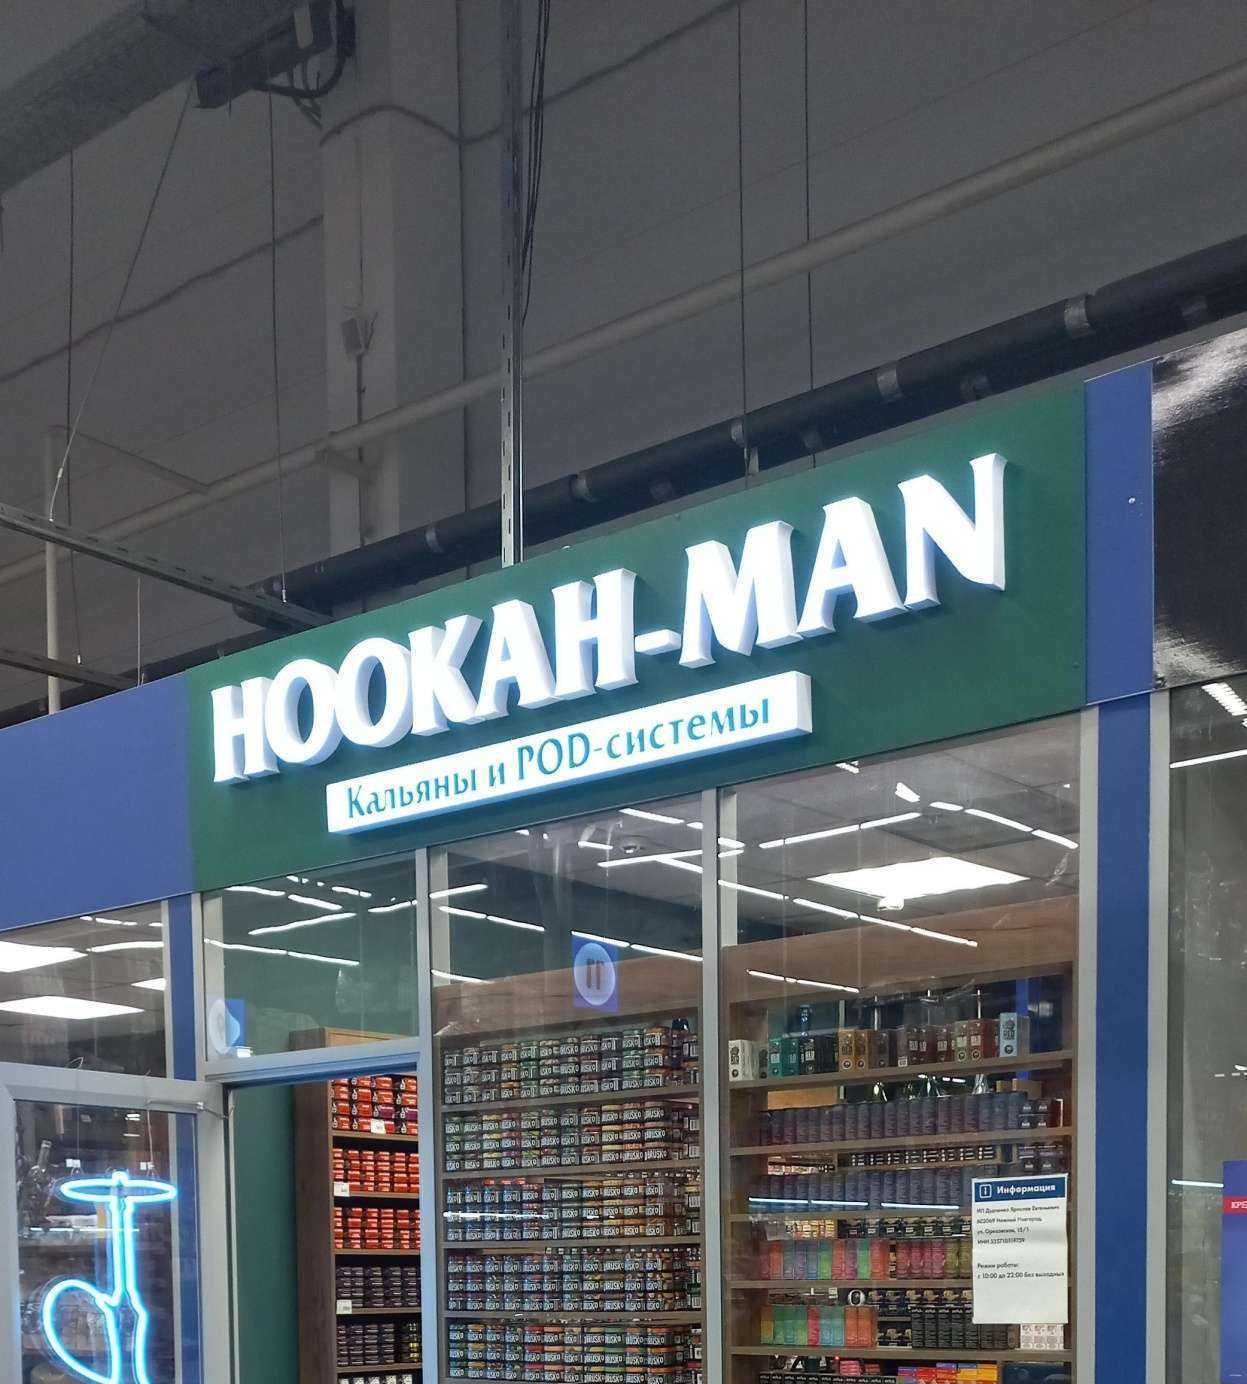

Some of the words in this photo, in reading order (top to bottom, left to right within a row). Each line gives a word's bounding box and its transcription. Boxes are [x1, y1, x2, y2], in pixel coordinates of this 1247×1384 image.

[211, 452, 1005, 783] HOOKAH-MAN
[347, 768, 477, 818] Кальяны
[488, 761, 505, 788] и
[517, 697, 769, 780] POD-системы
[996, 1184, 1056, 1195] Информация
